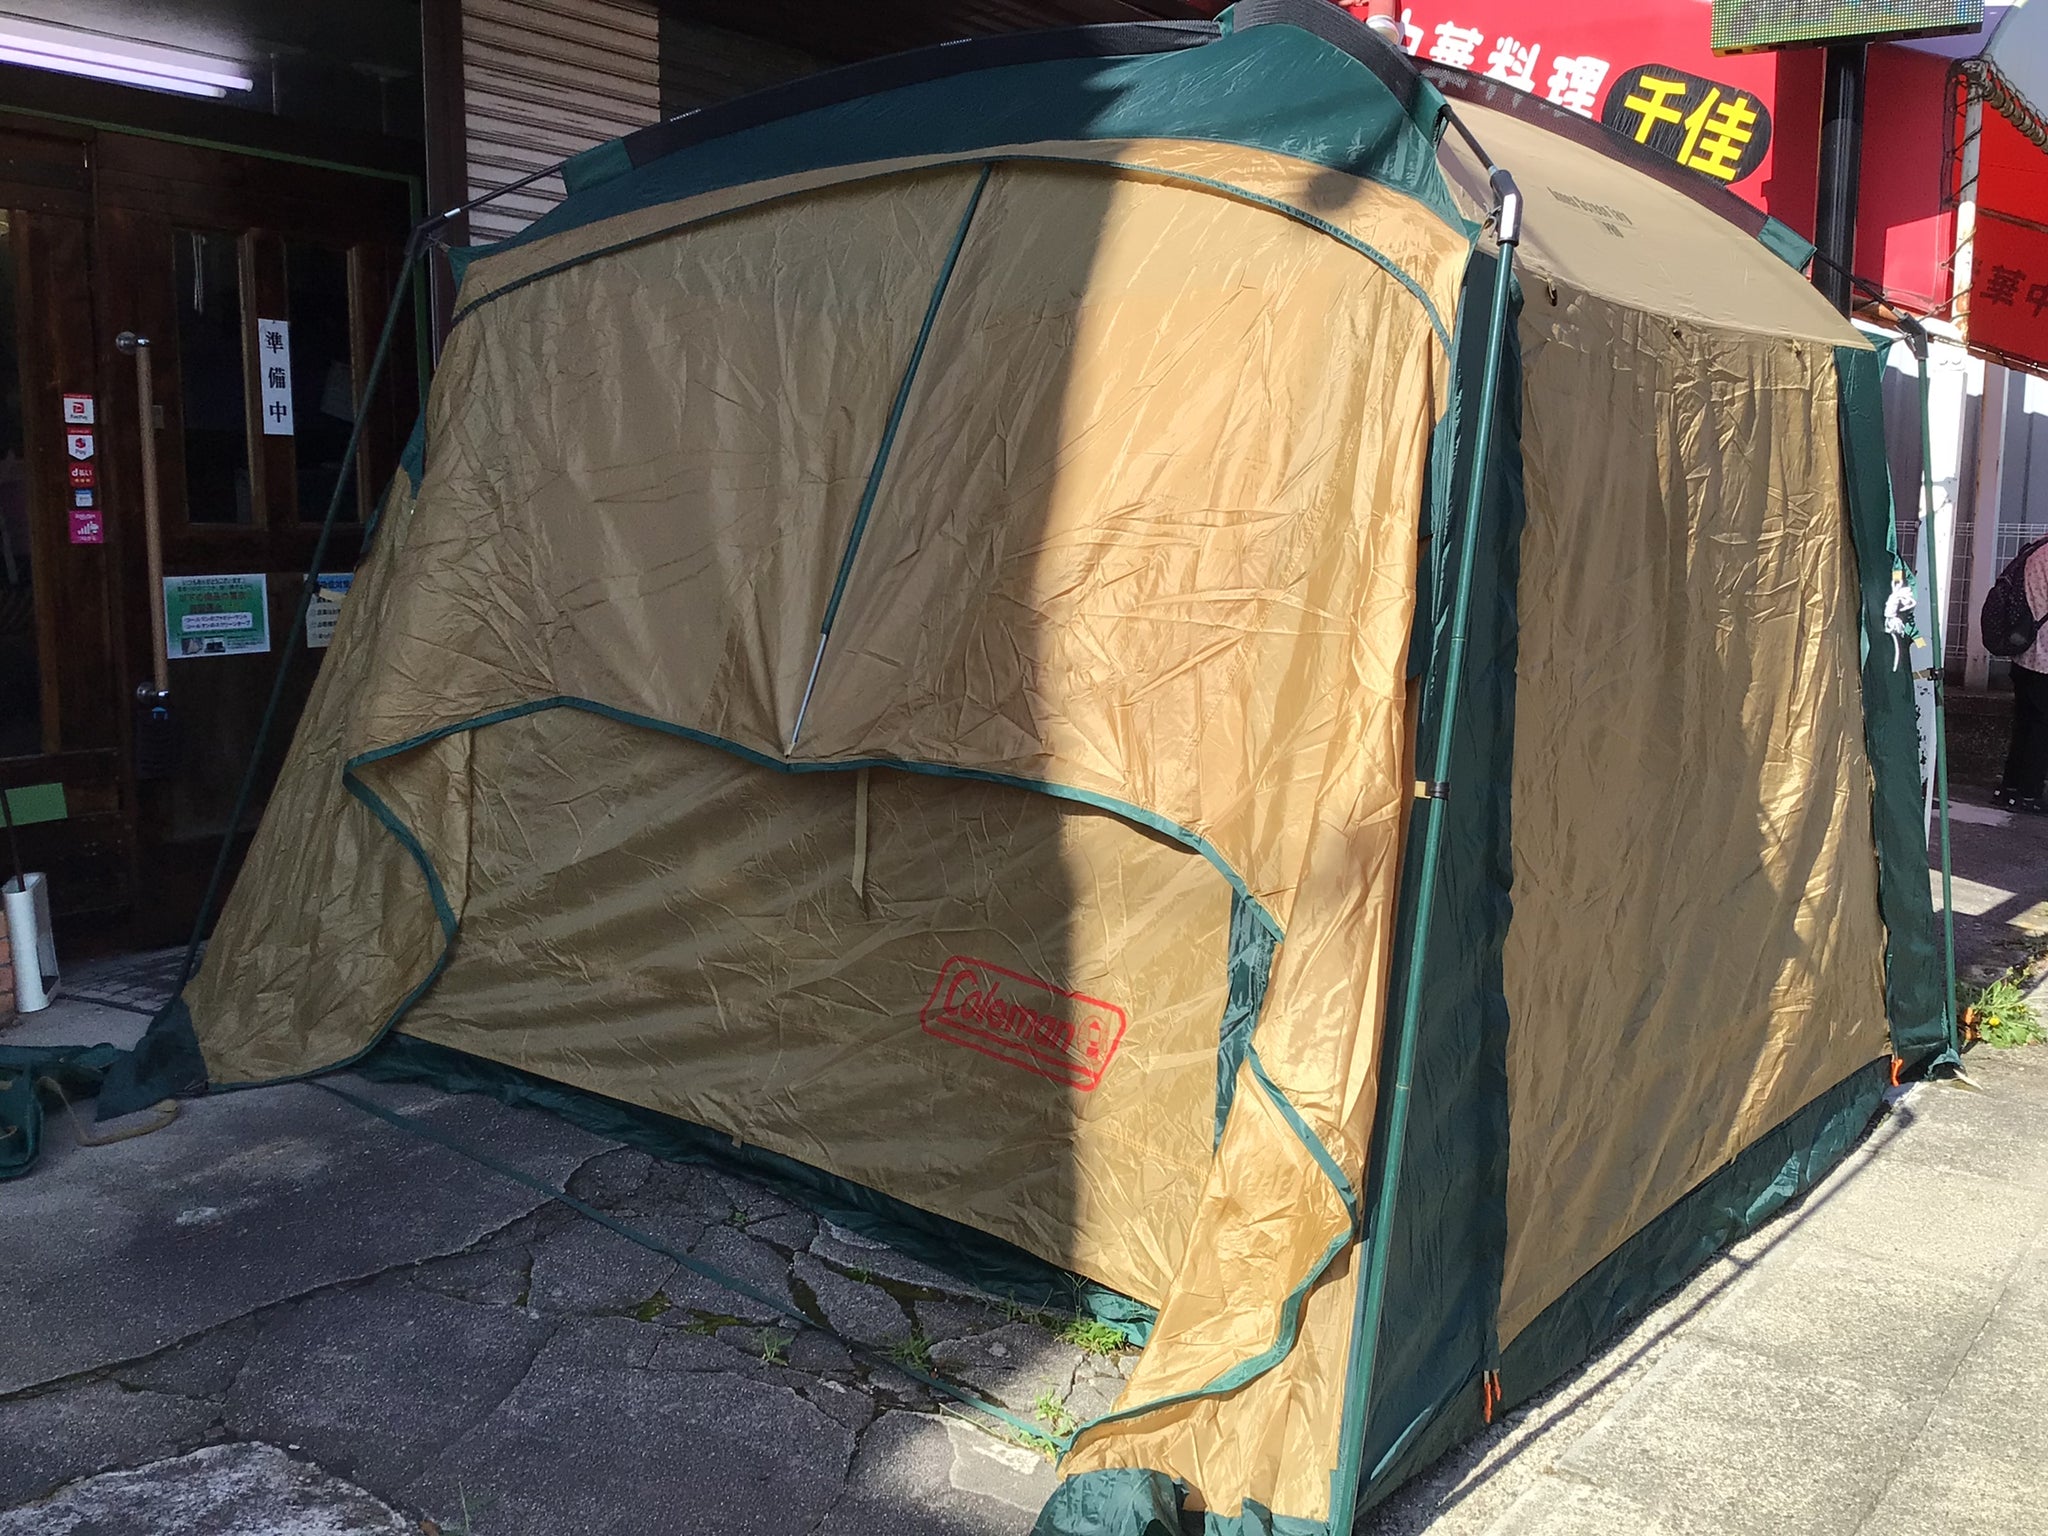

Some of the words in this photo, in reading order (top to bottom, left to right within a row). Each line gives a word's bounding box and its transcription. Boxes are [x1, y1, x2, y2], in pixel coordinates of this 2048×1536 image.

[1624, 75, 1757, 181] 千佳
[265, 331, 287, 423] 準備中
[943, 969, 1075, 1055] Coleman
